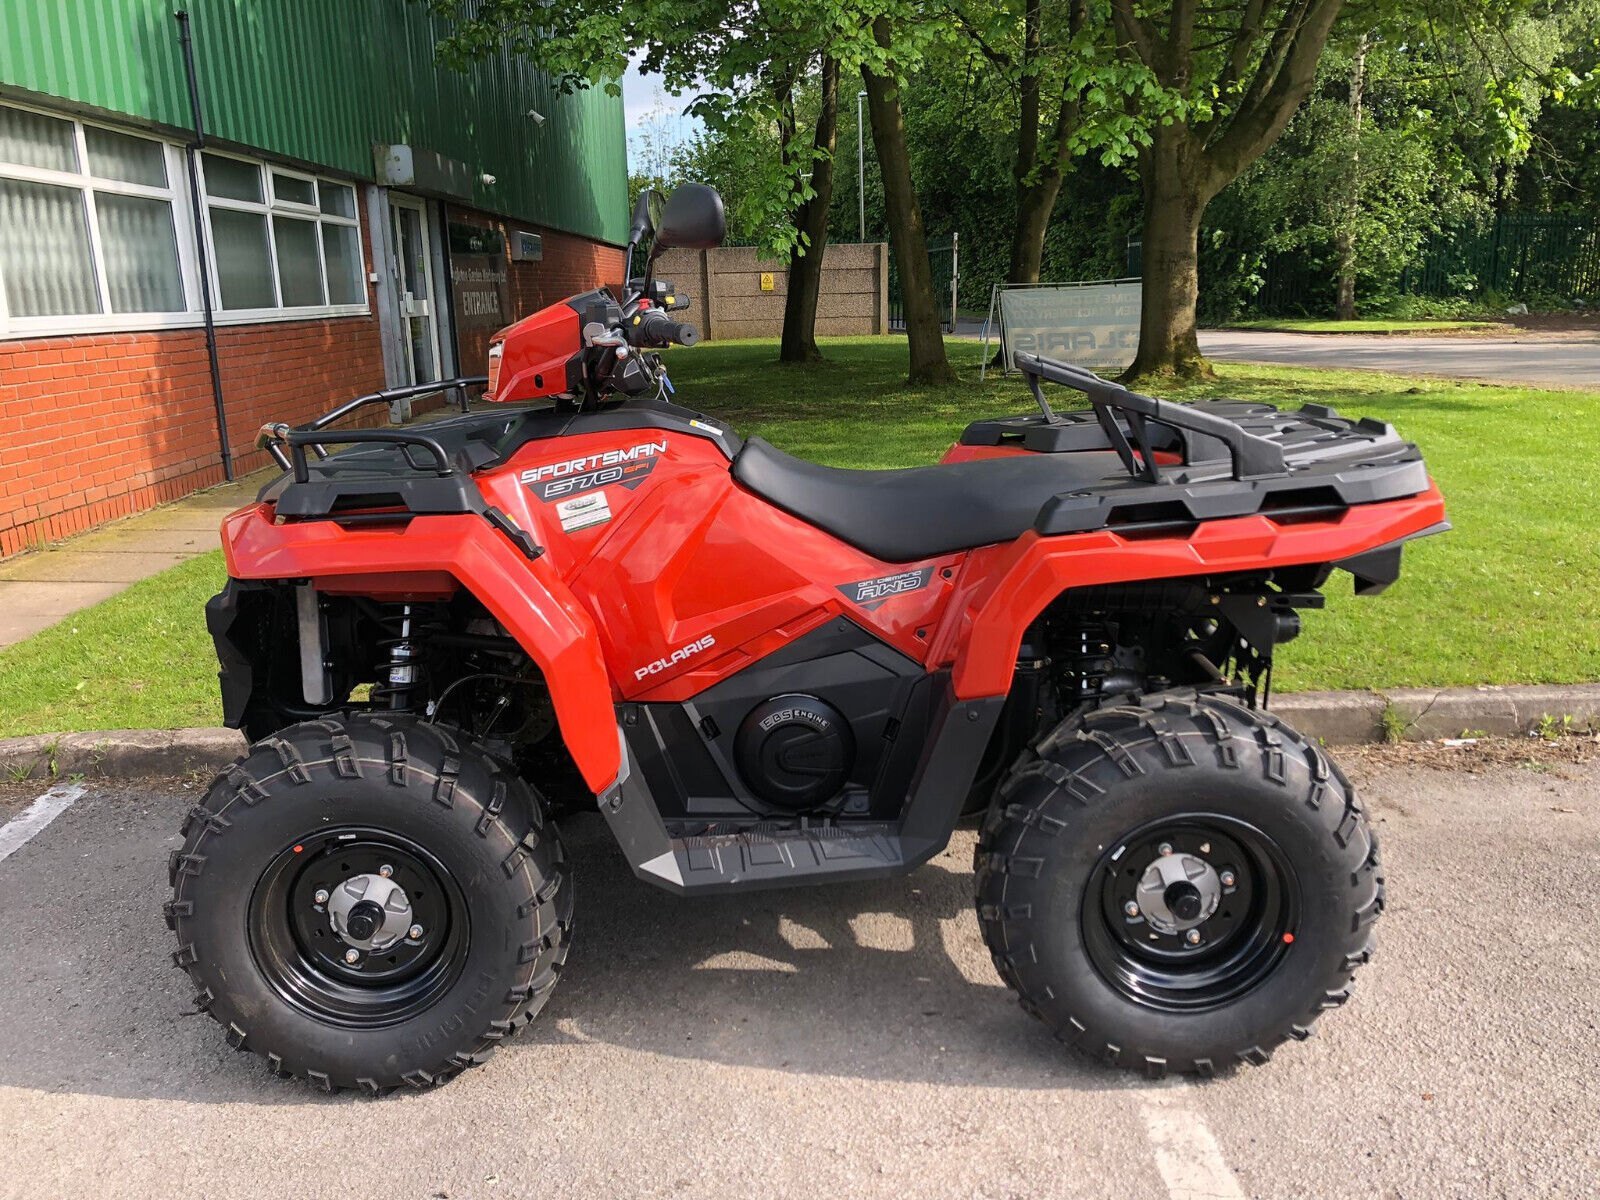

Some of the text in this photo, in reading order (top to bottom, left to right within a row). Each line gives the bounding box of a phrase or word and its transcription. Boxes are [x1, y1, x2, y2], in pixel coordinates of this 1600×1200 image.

[463, 291, 499, 316] ENTRANCE
[520, 441, 667, 484] SPORTSMAN
[544, 462, 650, 498] 570 EFI
[856, 576, 922, 601] AWD
[857, 570, 922, 588] ON DEMAND
[634, 634, 716, 681] POLARIS
[762, 709, 829, 729] EBS ENGINE
